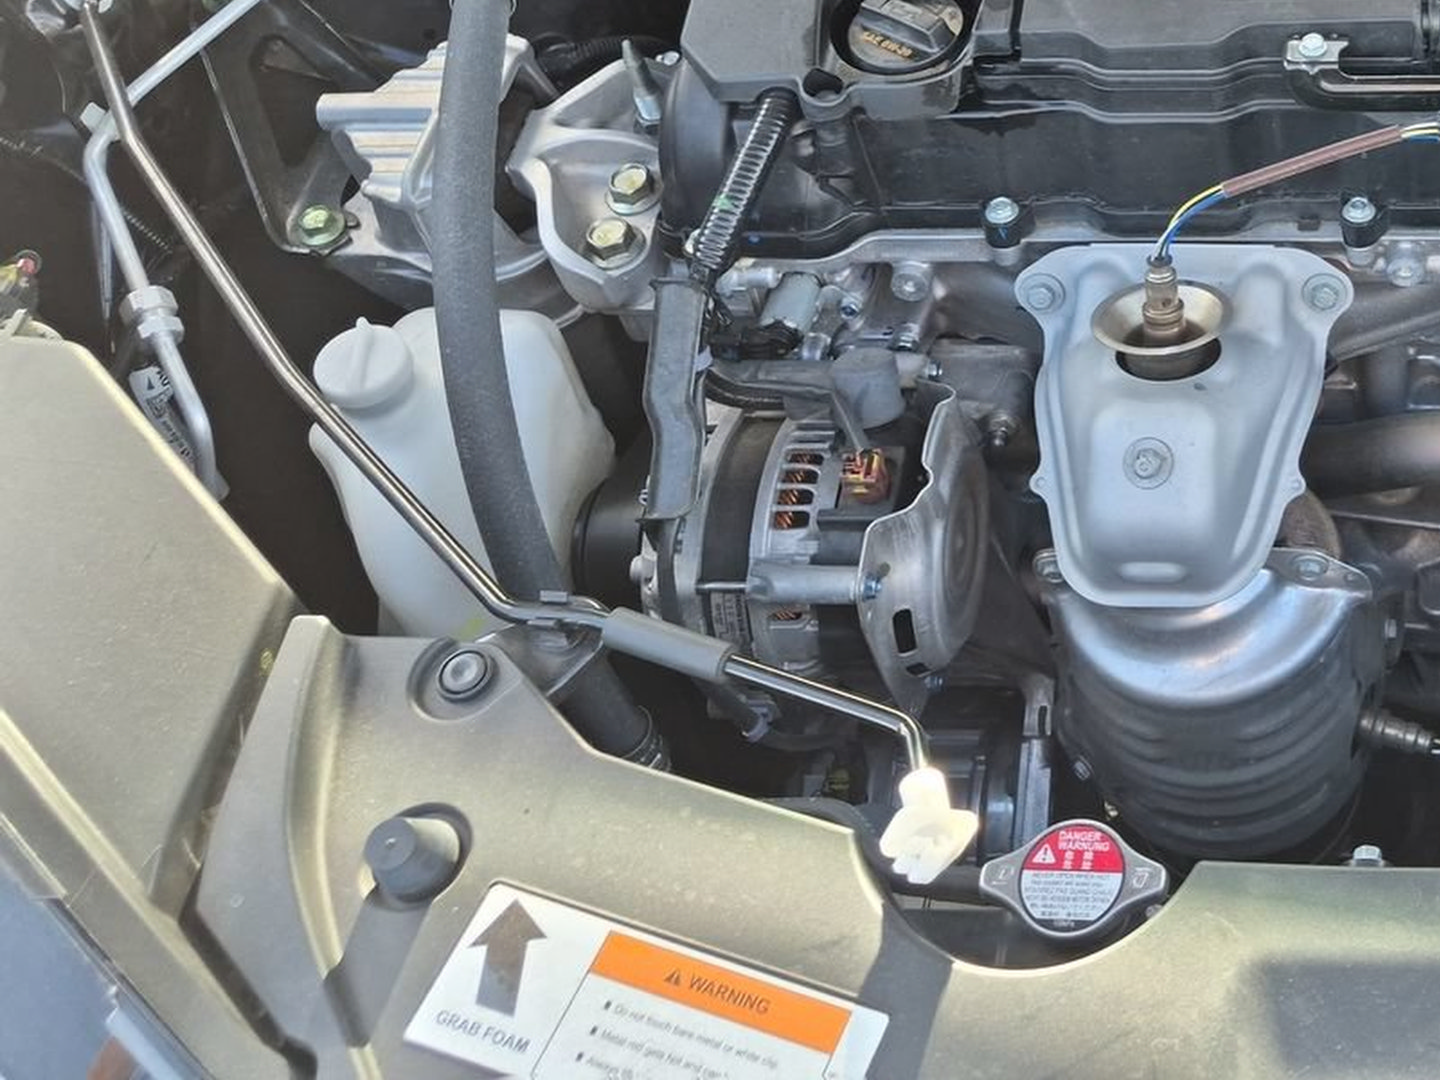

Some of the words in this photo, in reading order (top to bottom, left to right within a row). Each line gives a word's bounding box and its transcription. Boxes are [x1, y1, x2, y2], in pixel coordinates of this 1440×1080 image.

[1059, 830, 1103, 841] DANGER
[689, 973, 771, 1016] WARNING
[436, 1010, 481, 1036] GRAB
[482, 1027, 531, 1053] FOAM
